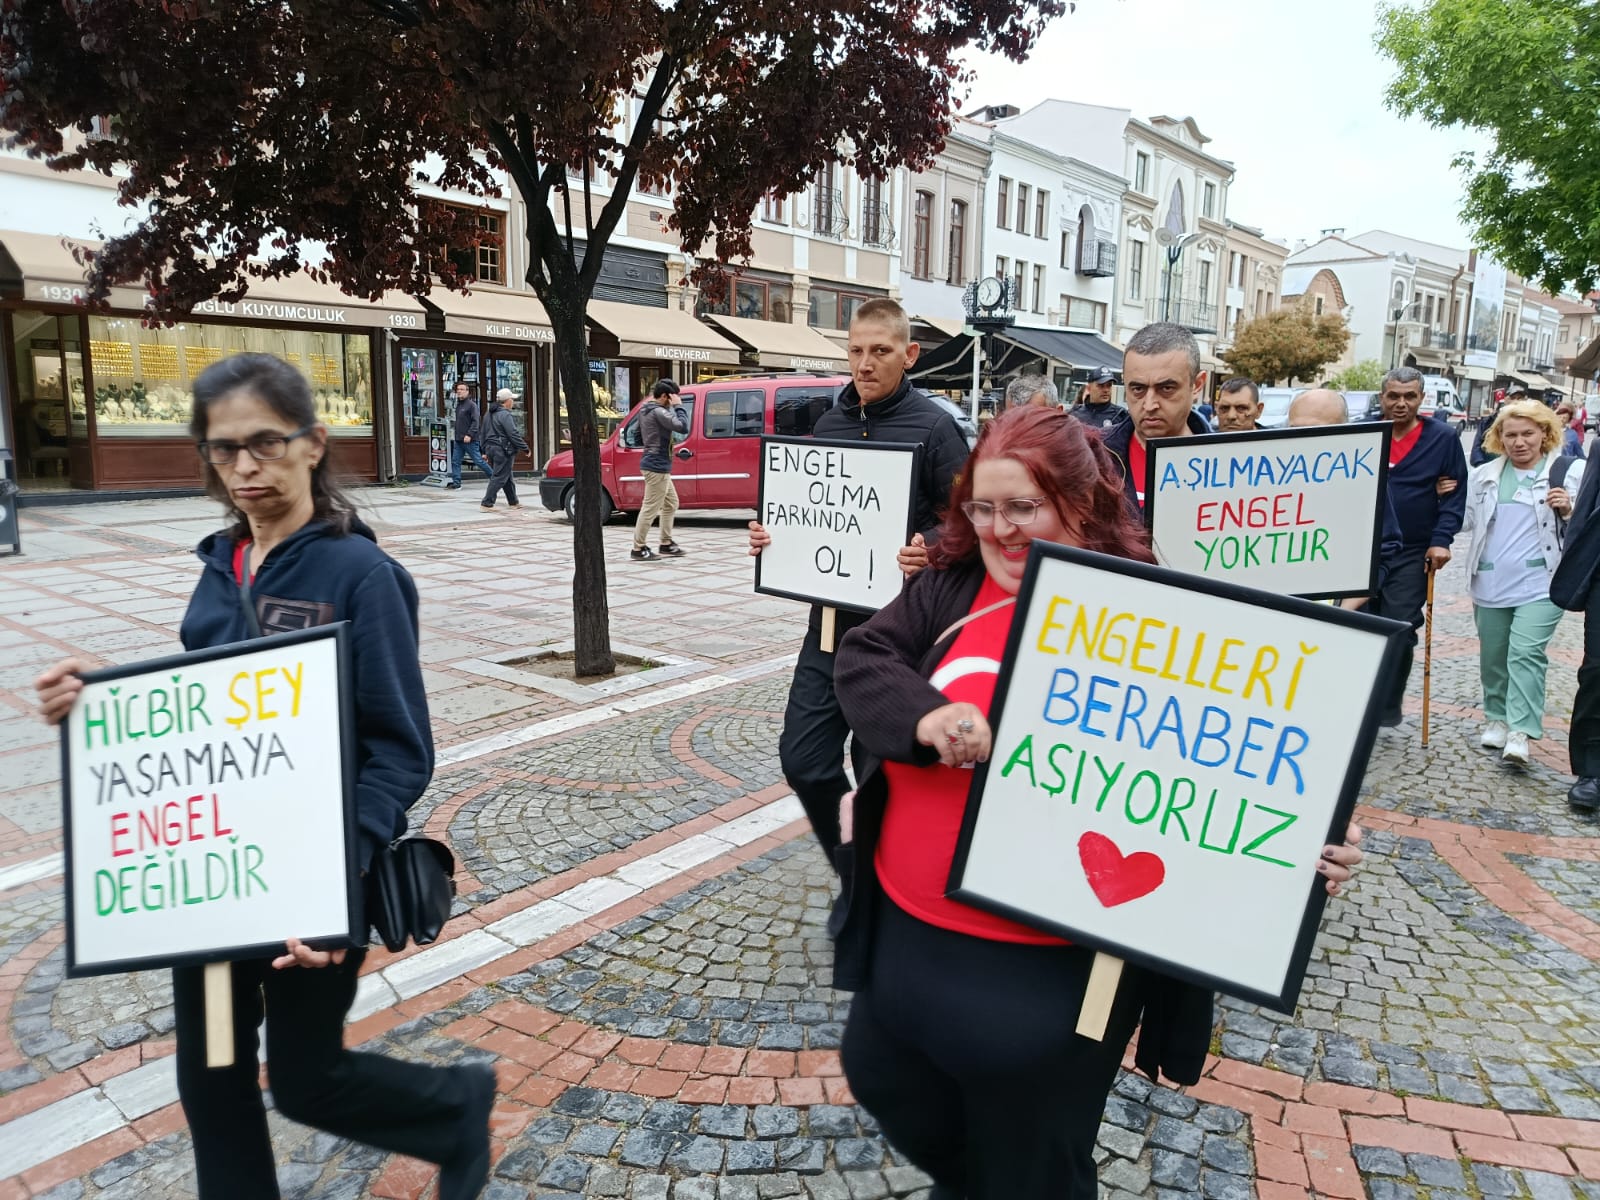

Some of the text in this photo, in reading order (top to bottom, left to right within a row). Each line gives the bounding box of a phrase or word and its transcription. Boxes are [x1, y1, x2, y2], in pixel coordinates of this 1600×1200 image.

[40, 285, 82, 302] 1930
[243, 302, 345, 322] KUYUMCULUK
[387, 314, 416, 328] 1930
[486, 324, 555, 341] KILIF DÜNYAS
[655, 346, 712, 361] MÜCEVHERAT
[790, 356, 834, 370] MÜCEVHERAT
[769, 445, 852, 479] ENGEL
[808, 481, 881, 512] OLMA
[1196, 492, 1315, 532] ENGEL
[766, 502, 862, 535] FARKINDA
[815, 545, 851, 578] OL
[1194, 528, 1330, 572] YOKTUR
[1036, 595, 1320, 711] ENGELLERİ
[84, 661, 304, 750] HİÇBİR ŞEY
[1042, 667, 1310, 796] BERABER
[90, 732, 294, 805] YAŞAMAYA
[1000, 734, 1299, 868] AŞIYORUZ
[111, 794, 233, 857] ENGEL
[94, 835, 269, 917] DEĞİLDİR
